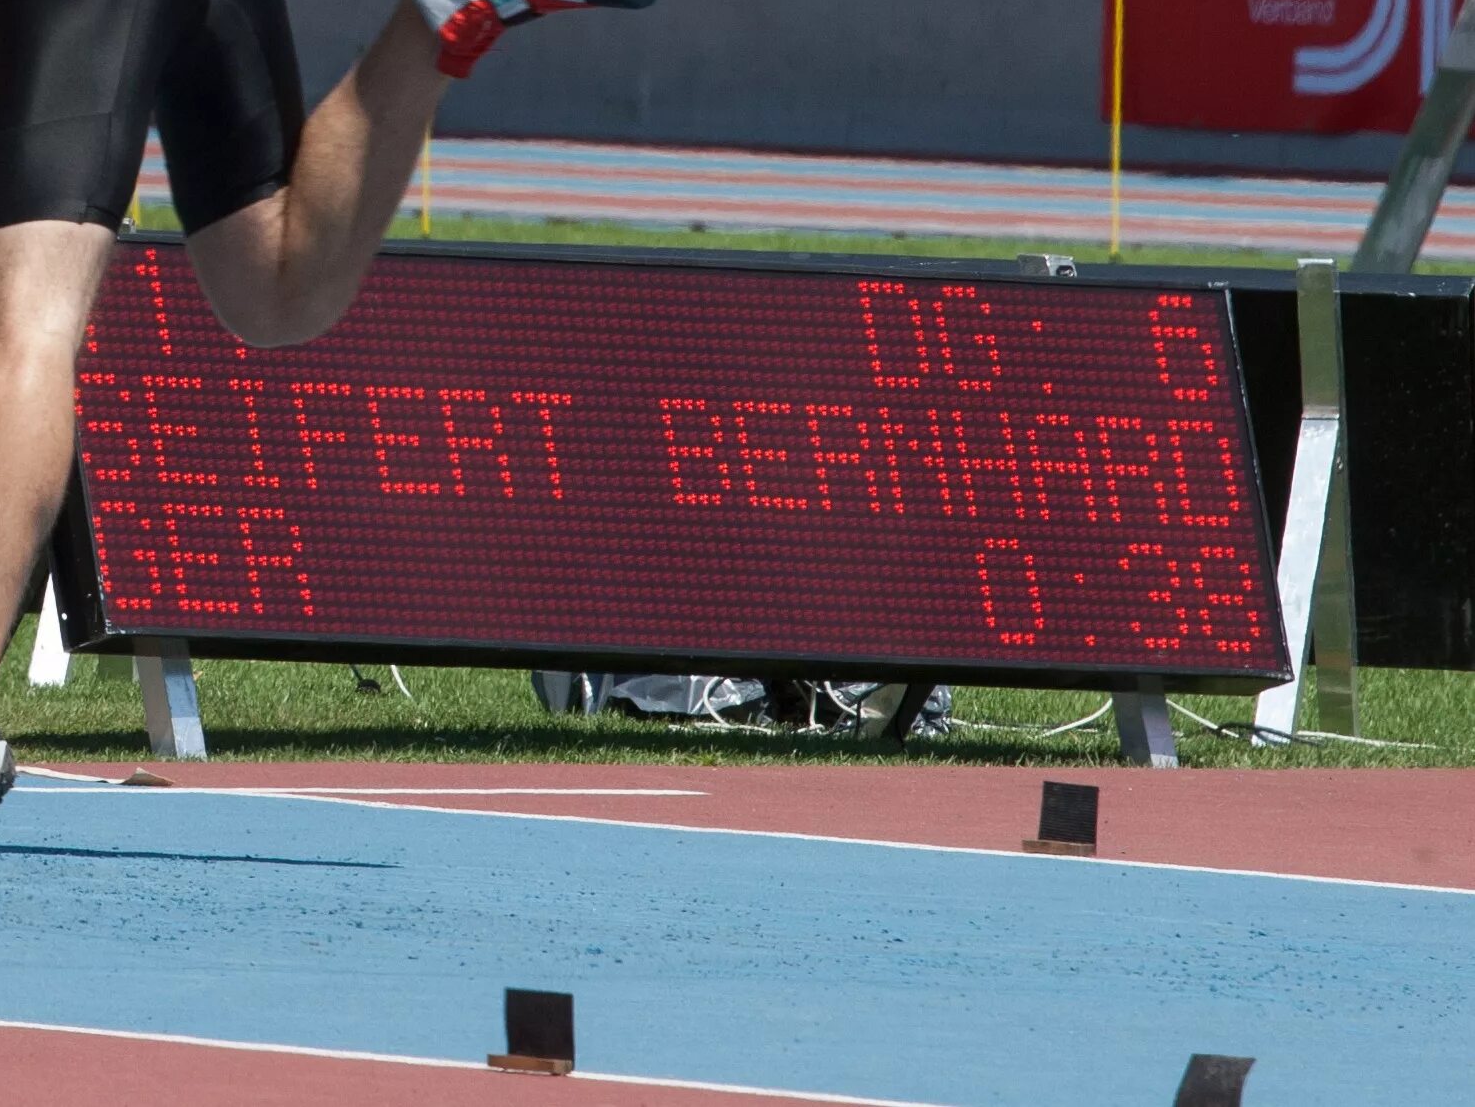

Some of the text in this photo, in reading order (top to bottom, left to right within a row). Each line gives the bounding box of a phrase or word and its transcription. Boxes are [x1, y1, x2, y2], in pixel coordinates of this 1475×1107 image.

[1148, 294, 1218, 401] 6
[73, 371, 1240, 527] SEIFERT BERNHARD
[91, 499, 314, 616] GER
